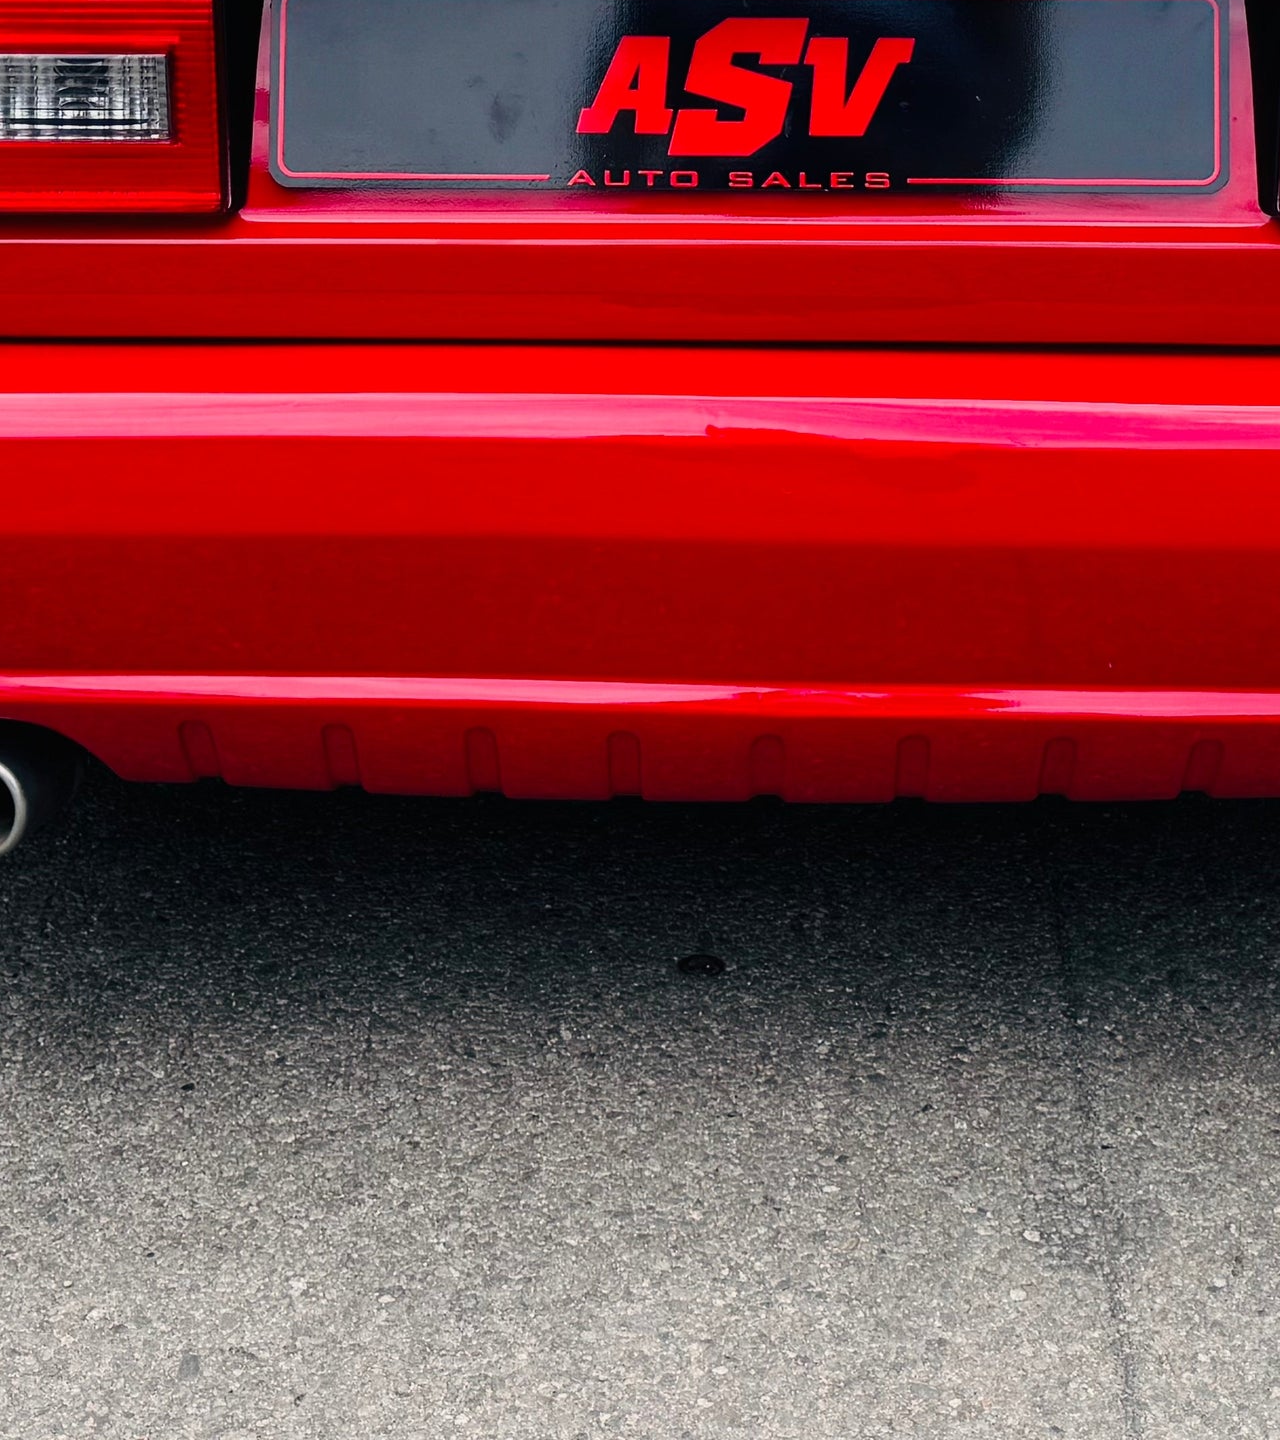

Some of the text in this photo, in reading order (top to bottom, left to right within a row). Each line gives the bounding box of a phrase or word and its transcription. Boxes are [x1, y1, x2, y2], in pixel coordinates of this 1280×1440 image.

[575, 17, 916, 156] ASV
[567, 169, 891, 189] AUTO SALES
